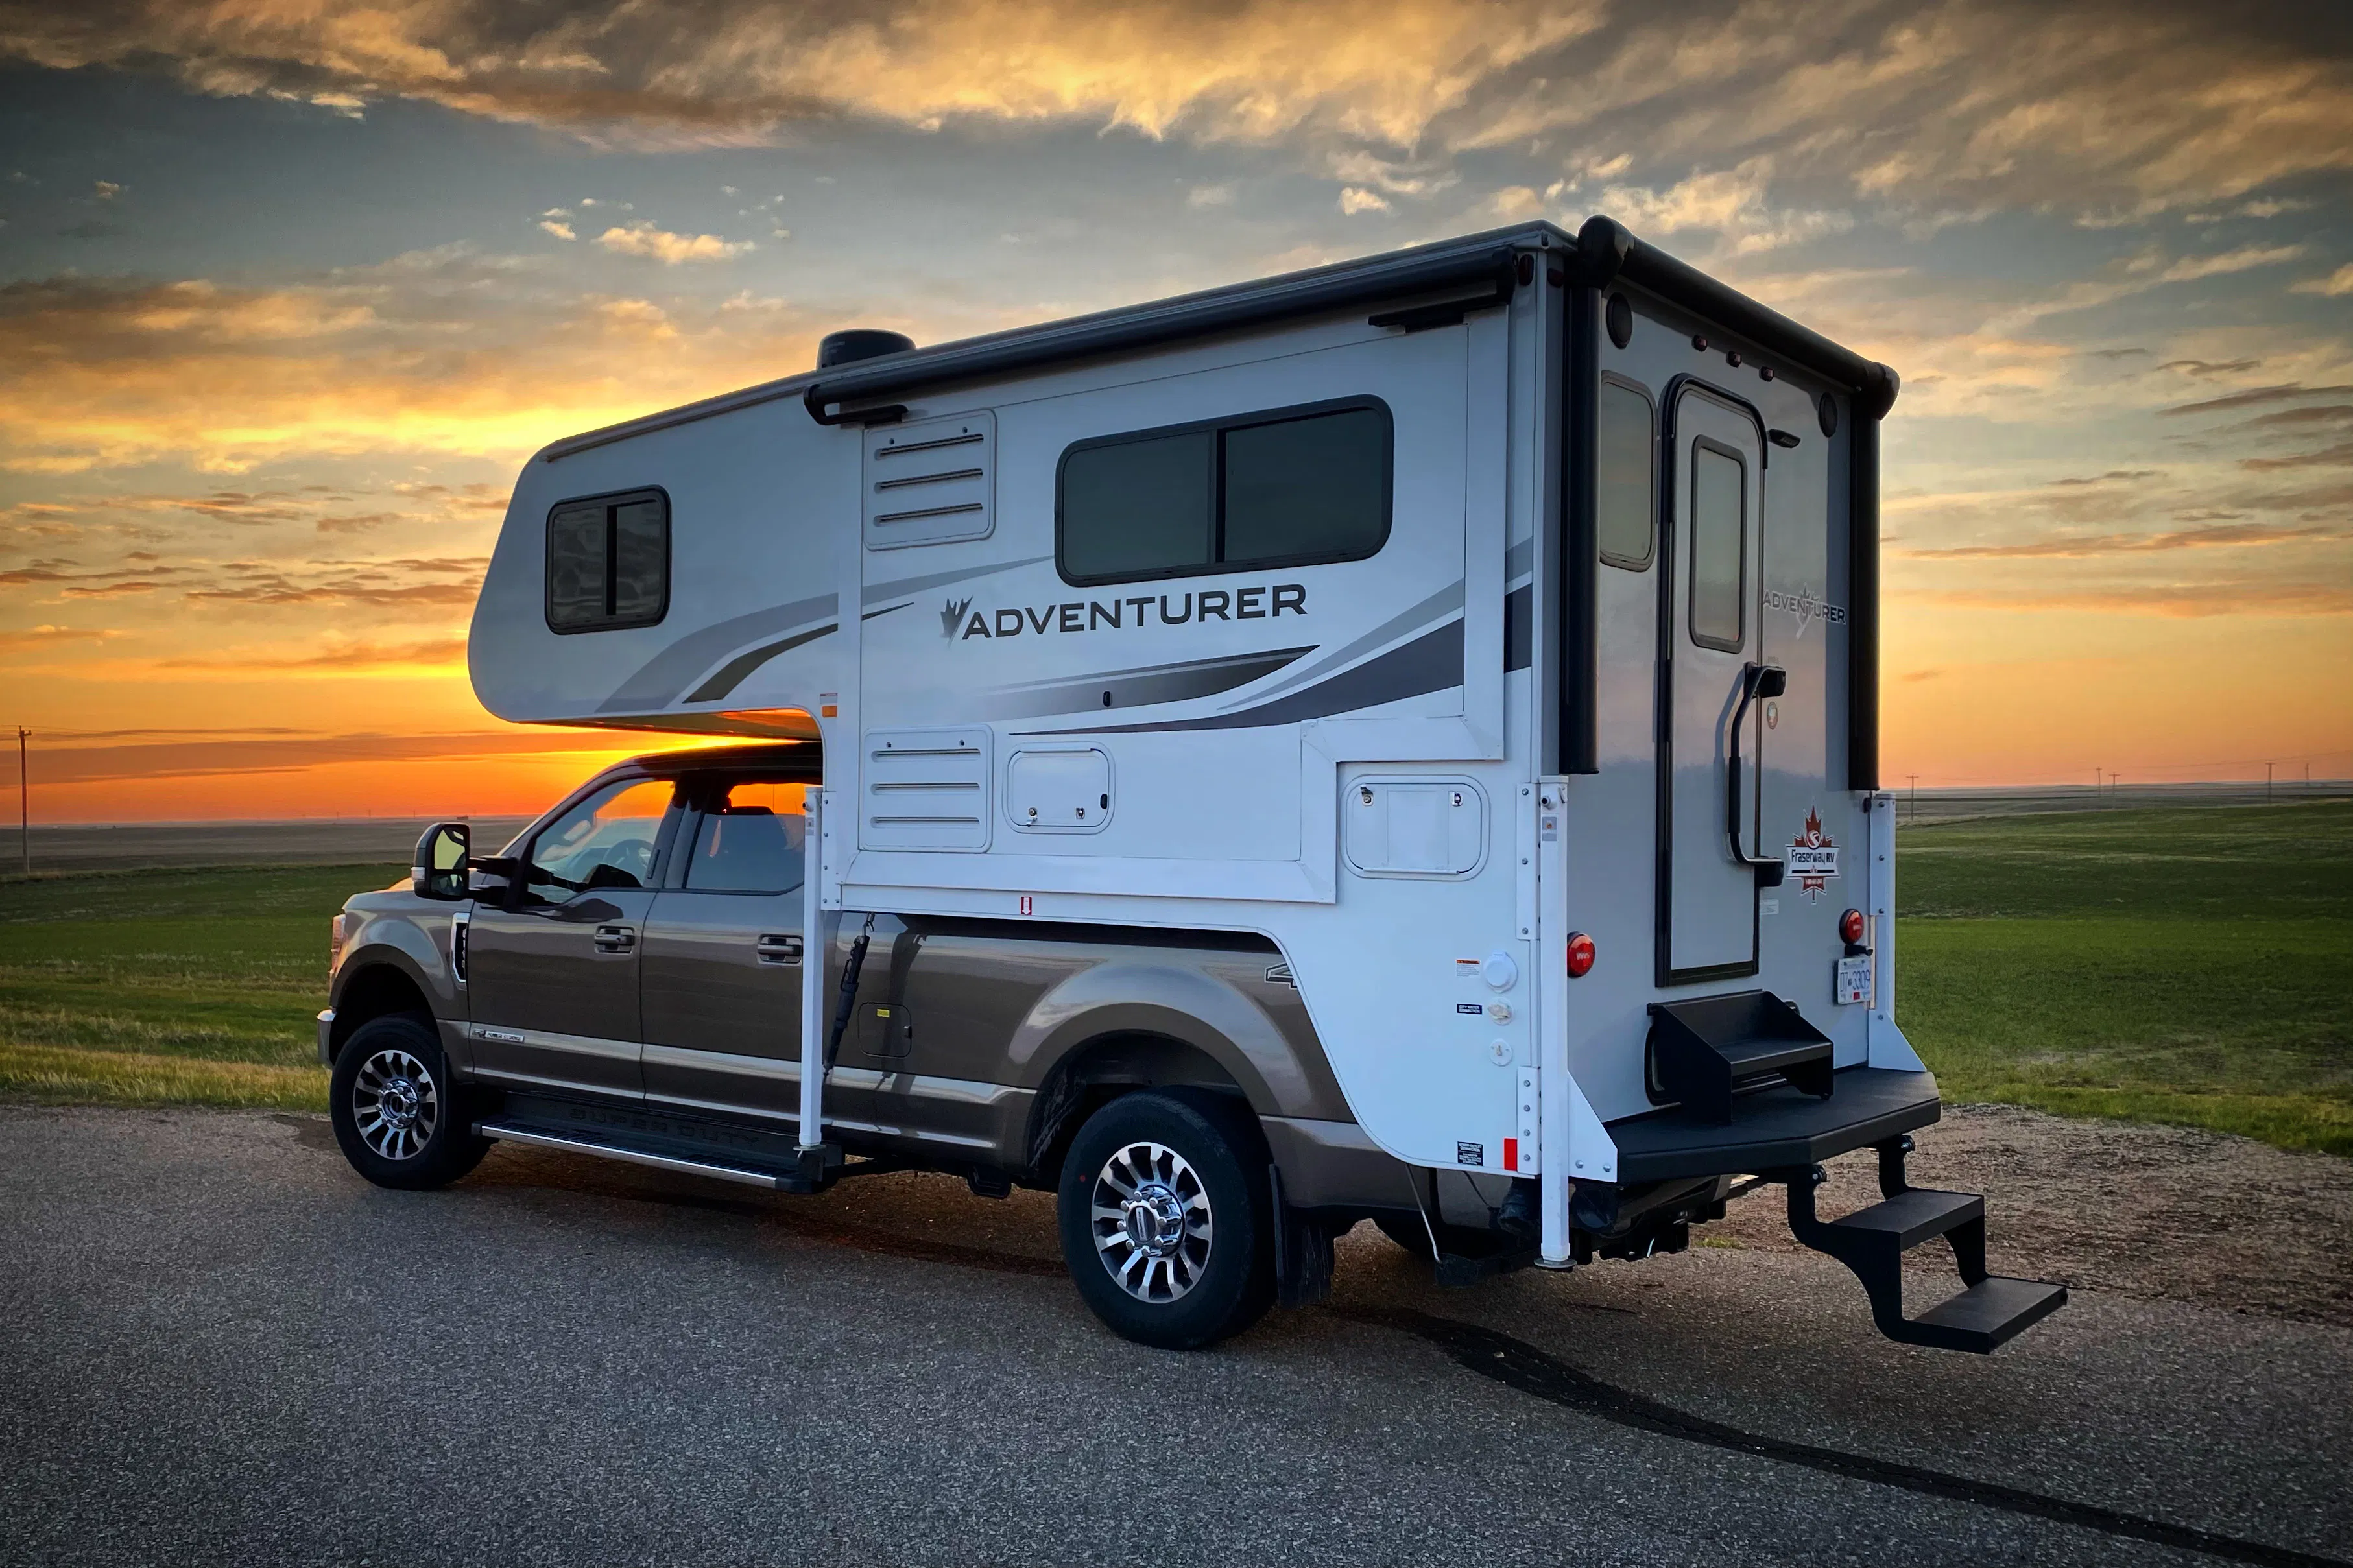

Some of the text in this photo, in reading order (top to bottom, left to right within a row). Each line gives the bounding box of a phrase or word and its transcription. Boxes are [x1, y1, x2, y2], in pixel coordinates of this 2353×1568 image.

[962, 584, 1308, 640] ADVENTURER
[1763, 590, 1846, 624] ADVENTURER
[1791, 849, 1835, 865] Fraserway RV
